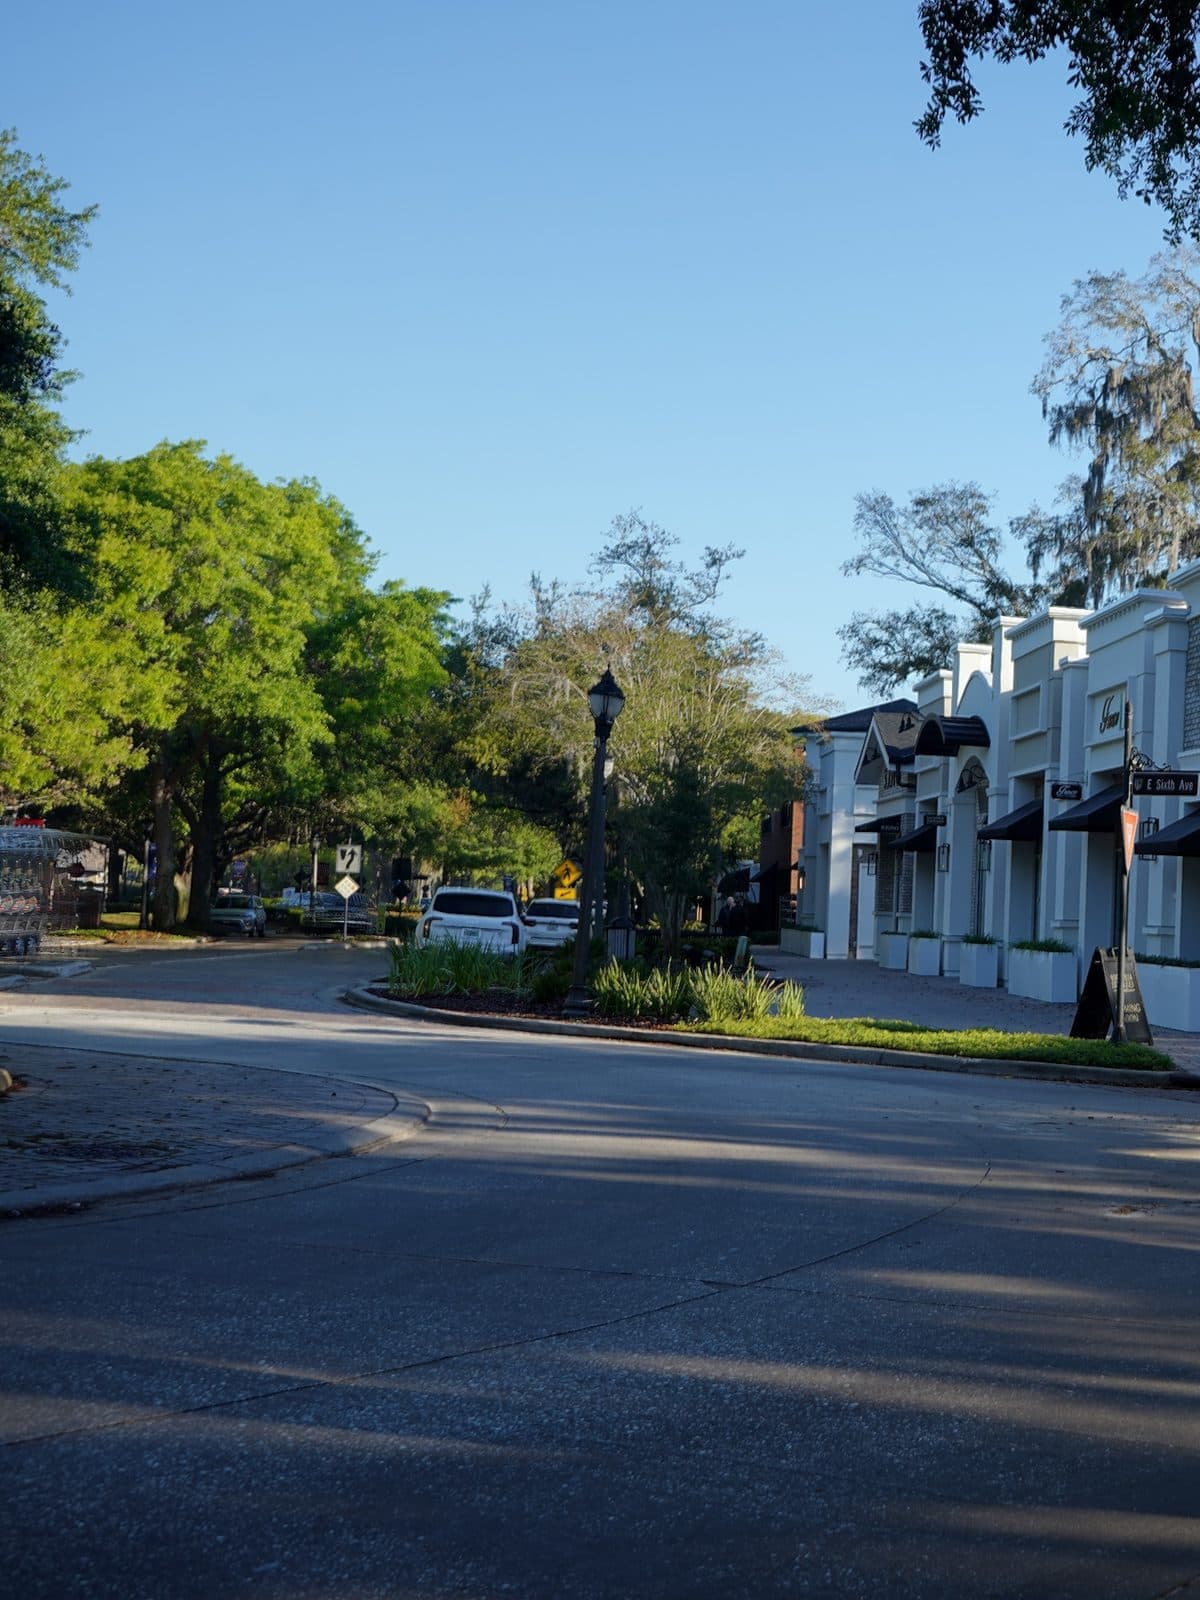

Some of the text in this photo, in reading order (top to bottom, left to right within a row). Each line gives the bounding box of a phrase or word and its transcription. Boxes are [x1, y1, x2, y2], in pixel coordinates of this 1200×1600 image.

[1147, 778, 1194, 791] E Sixth Ave
